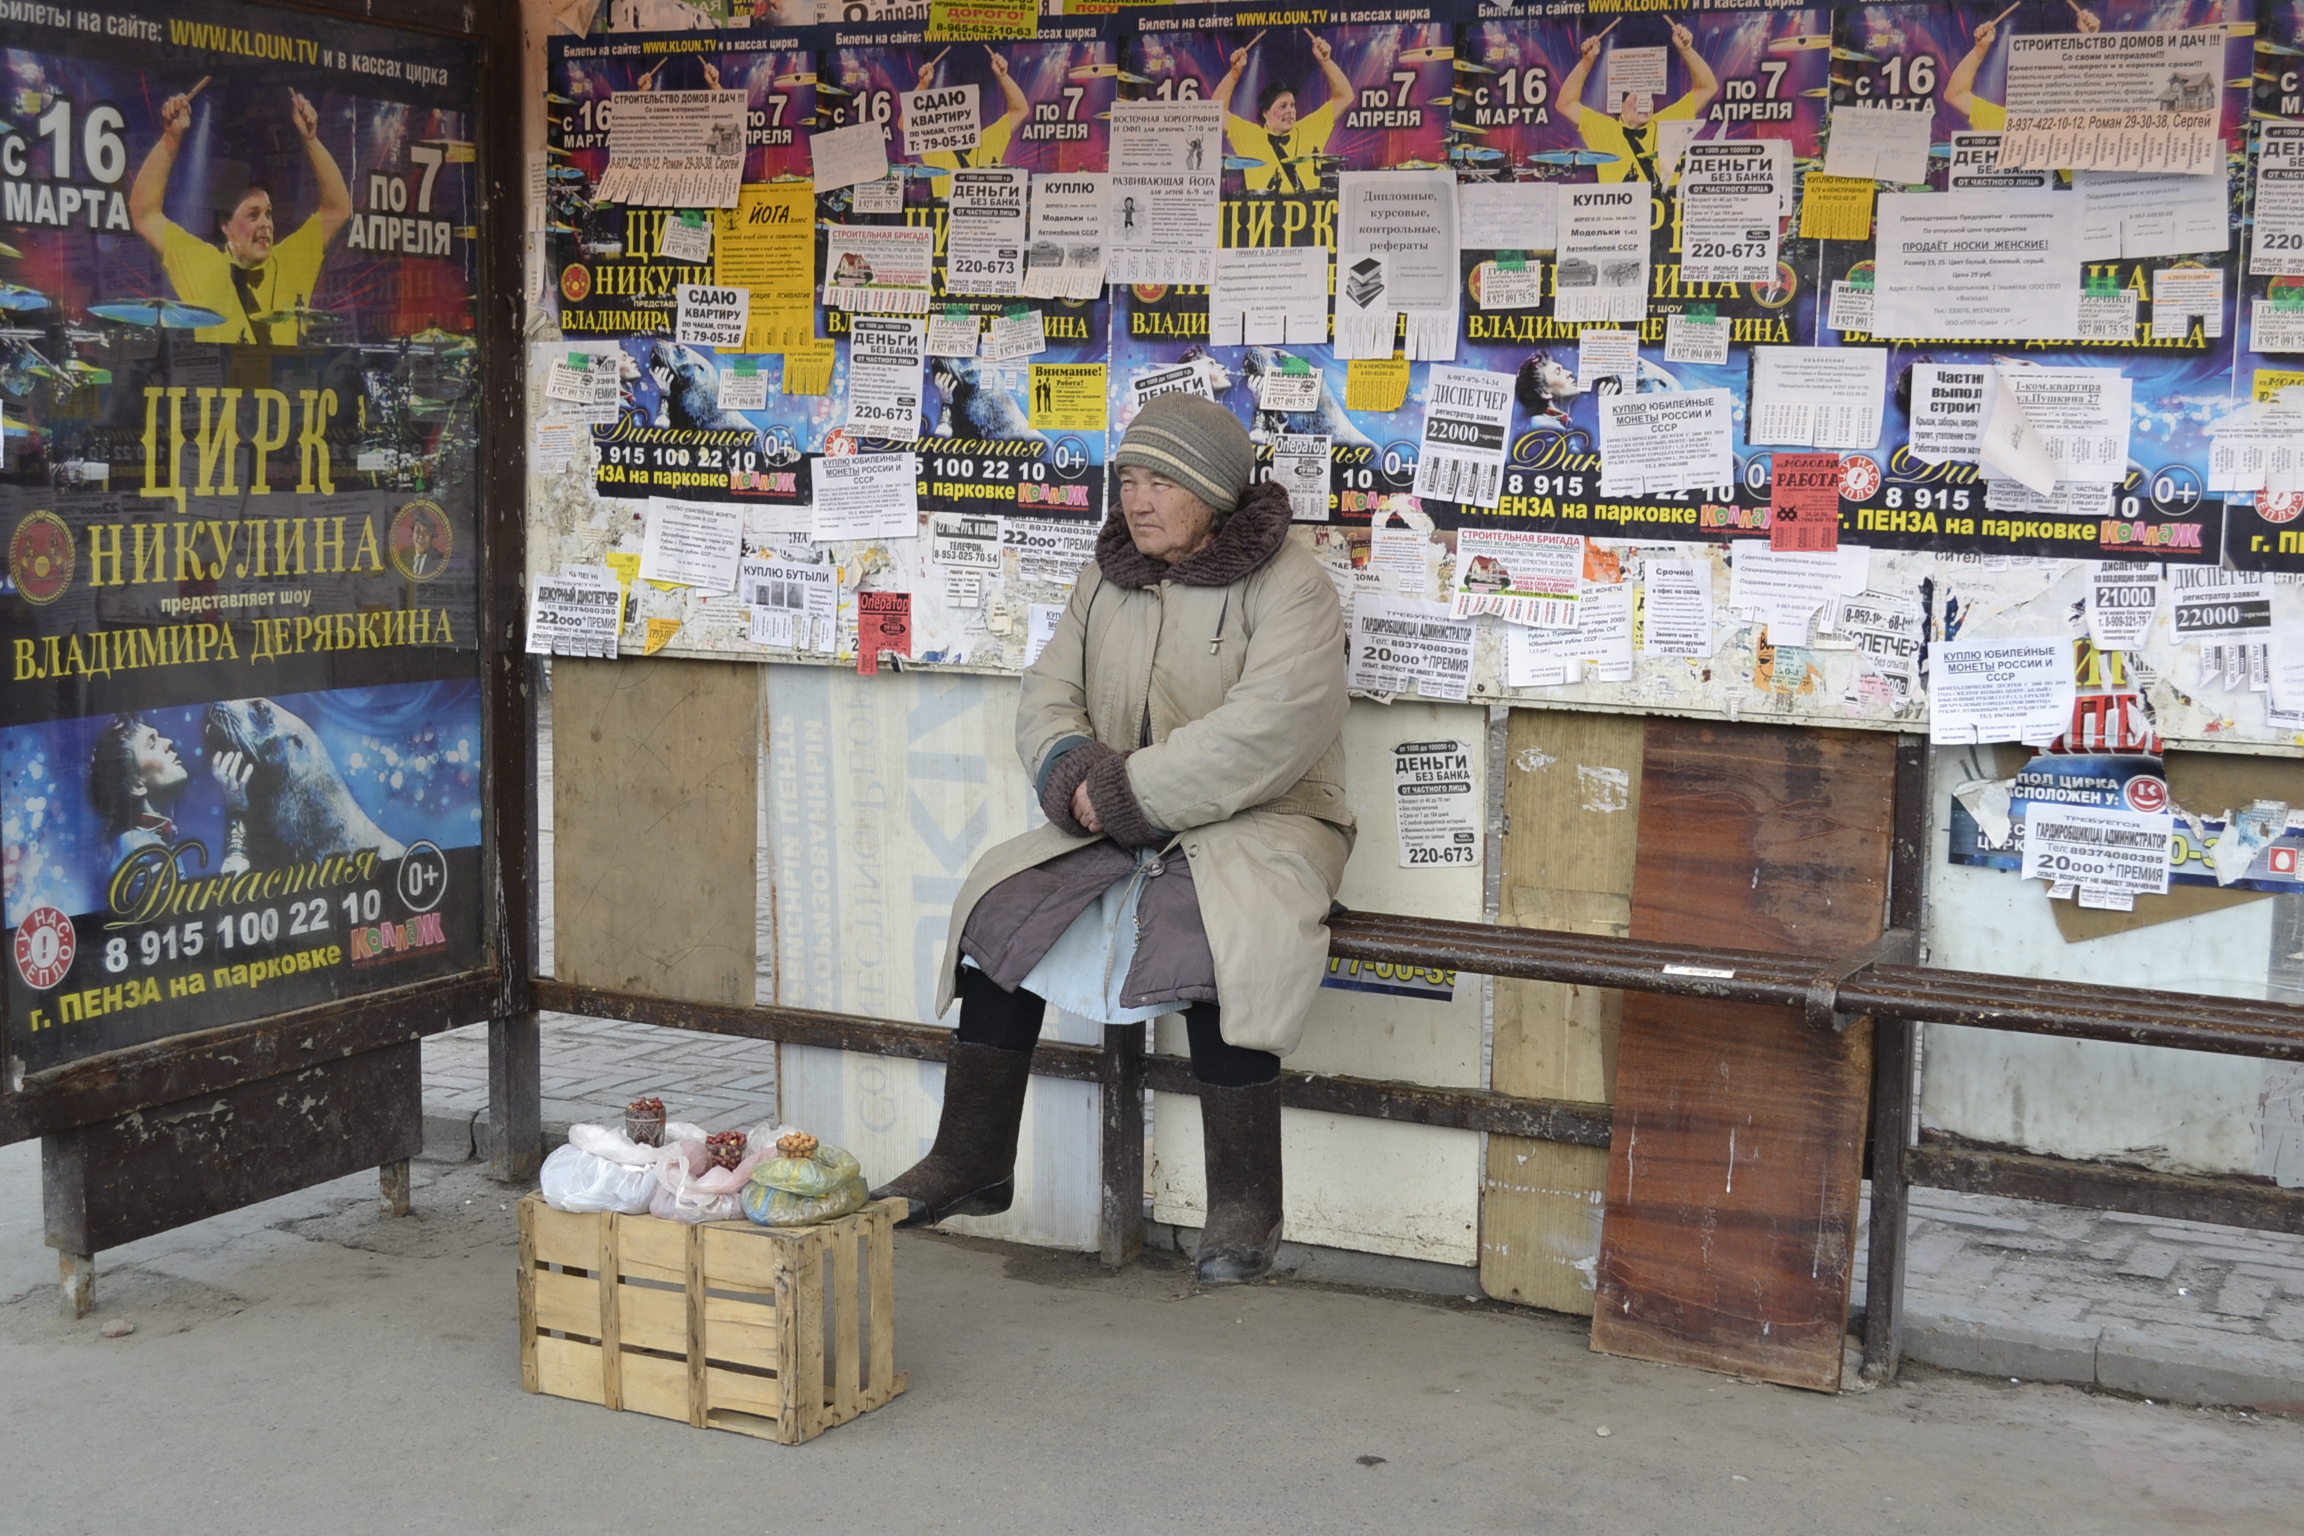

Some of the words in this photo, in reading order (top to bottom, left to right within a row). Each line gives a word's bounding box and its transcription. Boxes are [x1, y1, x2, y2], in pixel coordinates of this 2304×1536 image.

[947, 8, 1025, 20] ДОРОГО!
[1138, 17, 1179, 31] Билеты
[1182, 18, 1196, 29] на
[1198, 15, 1233, 29] сайте:
[1236, 10, 1327, 26] WWW.KLOUN.TV
[1350, 10, 1396, 21] кассах
[1399, 9, 1430, 21] цирка
[936, 23, 1032, 36] 8-965-632-10-63
[77, 12, 100, 32] на
[107, 16, 162, 42] сайте:
[170, 19, 318, 66] WWW.KLOUN.TV
[323, 50, 333, 68] и
[338, 52, 347, 70] в
[351, 53, 402, 79] кассах
[406, 62, 448, 87] цирка
[735, 39, 767, 50] кассах
[769, 38, 798, 50] цирка
[2013, 35, 2116, 51] СТРОИТЕЛЬСТВО
[2119, 35, 2164, 50] ДОМОВ
[2168, 35, 2176, 46] И
[2180, 35, 2205, 49] ДАЧ
[1761, 62, 1787, 99] 7
[1880, 56, 1935, 95] 16
[1393, 72, 1416, 106] 7
[1498, 68, 1548, 104] 16
[614, 94, 680, 105] СТРОИТЕЛЬСТВО
[681, 93, 710, 106] ДОМОВ
[719, 93, 735, 104] ДАЧ
[852, 90, 892, 123] 16
[913, 90, 966, 111] СДАЮ
[911, 109, 972, 127] КВАРТИРУ
[1113, 115, 1160, 123] ВОСТОЧНАЯ
[1163, 115, 1220, 123] ХОРЕОГРАФИЯ
[1347, 110, 1421, 128] АПРЕЛЯ
[1476, 108, 1549, 125] МАРТА
[1709, 102, 1793, 121] АПРЕЛЯ
[2089, 116, 2121, 129] Роман
[2124, 114, 2170, 130] 29-30-38,
[2173, 113, 2211, 129] Сергей
[39, 100, 126, 184] 16
[923, 133, 976, 150] 79-05-16
[662, 158, 683, 169] Роман
[715, 156, 739, 171] Сергей
[1689, 159, 1773, 174] ДЕНЬГИ
[410, 145, 444, 213] 7
[1112, 177, 1184, 186] РАЗВИВАЮЩАЯ
[1189, 176, 1215, 186] ЙОГА
[1711, 173, 1732, 181] БЕЗ
[1736, 173, 1774, 181] БАНКА
[1363, 191, 1437, 202] Дипломные,
[1706, 185, 1746, 193] ЧАСТНОГО
[1747, 185, 1768, 193] ЛИЦА
[3, 181, 131, 231] МАРТА
[1573, 192, 1633, 206] КУПЛЮ
[749, 202, 790, 224] ЙОГА
[1370, 209, 1430, 219] курсовые,
[348, 214, 451, 256] АПРЕЛЯ
[832, 230, 892, 240] СТРОИТЕЛЬНАЯ
[893, 231, 930, 241] БРИГАДА
[1359, 225, 1440, 235] контрольные,
[1571, 228, 1621, 237] Модельки
[1369, 240, 1428, 251] рефераты
[1566, 244, 1616, 252] Автомобилей
[1617, 243, 1639, 251] СССР
[1691, 243, 1766, 258] 220-673
[1902, 240, 1948, 251] ПРОДАЁТ
[1953, 241, 1989, 251] НОСКИ
[1994, 240, 2049, 250] ЖЕНСКИЕ!
[956, 260, 1015, 274] 220-673
[688, 289, 737, 306] СДАЮ
[561, 311, 671, 333] ВЛАДИМИРА
[684, 307, 741, 321] КВАРТИРУ
[693, 331, 740, 344] 79-05-16
[853, 332, 918, 347] ДЕНЬГИ
[1035, 366, 1102, 378] Внимание!
[1431, 384, 1508, 411] ДИСПЕТЧЕР
[1612, 403, 1647, 413] КУПЛЮ
[1649, 398, 1714, 410] ЮБИЛЕЙНЫЕ
[1435, 408, 1475, 420] регистратор
[1476, 414, 1498, 422] заявок
[1617, 414, 1658, 424] МОНЕТЫ
[1661, 410, 1702, 420] РОССИИ
[1428, 420, 1479, 442] 22000
[1651, 423, 1677, 432] СССР
[139, 386, 337, 513] ЦИРК
[609, 447, 645, 465] 915
[652, 447, 690, 467] 100
[698, 448, 723, 468] 22
[653, 468, 729, 489] парковке
[933, 460, 974, 478] 100
[982, 460, 1010, 479] 22
[1018, 462, 1046, 481] 10
[1776, 473, 1839, 487] РАБОТА
[932, 482, 1015, 500] парковке
[2155, 477, 2197, 504] 0+
[1857, 509, 1938, 534] ПЕНЗА
[1945, 517, 1975, 535] на
[1982, 517, 2096, 543] парковке
[1461, 530, 1534, 542] СТРОИТЕЛЬНАЯ
[1537, 535, 1580, 545] БРИГАДА
[87, 516, 384, 587] НИКУЛИНА
[934, 550, 997, 563] 8-953-025-70-54
[744, 566, 783, 579] КУПЛЮ
[786, 569, 830, 583] БУТЫЛИ
[1656, 568, 1694, 577] Срочно!
[160, 588, 275, 613] представляет
[279, 585, 312, 609] шоу
[577, 590, 618, 605] ДИСПЕТЧЕР
[861, 594, 908, 612] Оператор
[2099, 588, 2151, 607] 21000
[1419, 622, 1472, 642] АДМИНИСТРАТОР
[12, 622, 239, 682] ВЛАДИМИРА
[250, 606, 454, 666] ДЕРЯБКИНА
[1944, 651, 1981, 660] КУПЛЮ
[1984, 647, 2055, 658] ЮБИЛЕЙНЫЕ
[1948, 662, 1995, 671] МОНЕТЫ
[1998, 660, 2042, 669] РОССИИ
[1396, 755, 1467, 774] ДЕНЬГИ
[1415, 771, 1434, 781] БЕЗ
[1437, 770, 1470, 781] БАНКА
[2059, 775, 2119, 791] ЦИРКА
[2064, 814, 2140, 828] ТРЕБУЕТСЯ
[2103, 829, 2167, 849] АДМИНИСТРАТОР
[1409, 847, 1473, 863] 220-673
[2037, 854, 2104, 873] 20000
[2070, 847, 2163, 864] 89374080395
[103, 837, 380, 929] Династия
[408, 859, 439, 896] 0+
[105, 936, 129, 973] 8
[141, 921, 204, 966] 915
[216, 908, 279, 948] 100
[289, 897, 328, 936] 22
[342, 888, 381, 925] 10
[30, 1010, 51, 1032] г.
[60, 977, 162, 1024] ПЕНЗА
[170, 971, 205, 998] на
[214, 946, 341, 988] парковке
